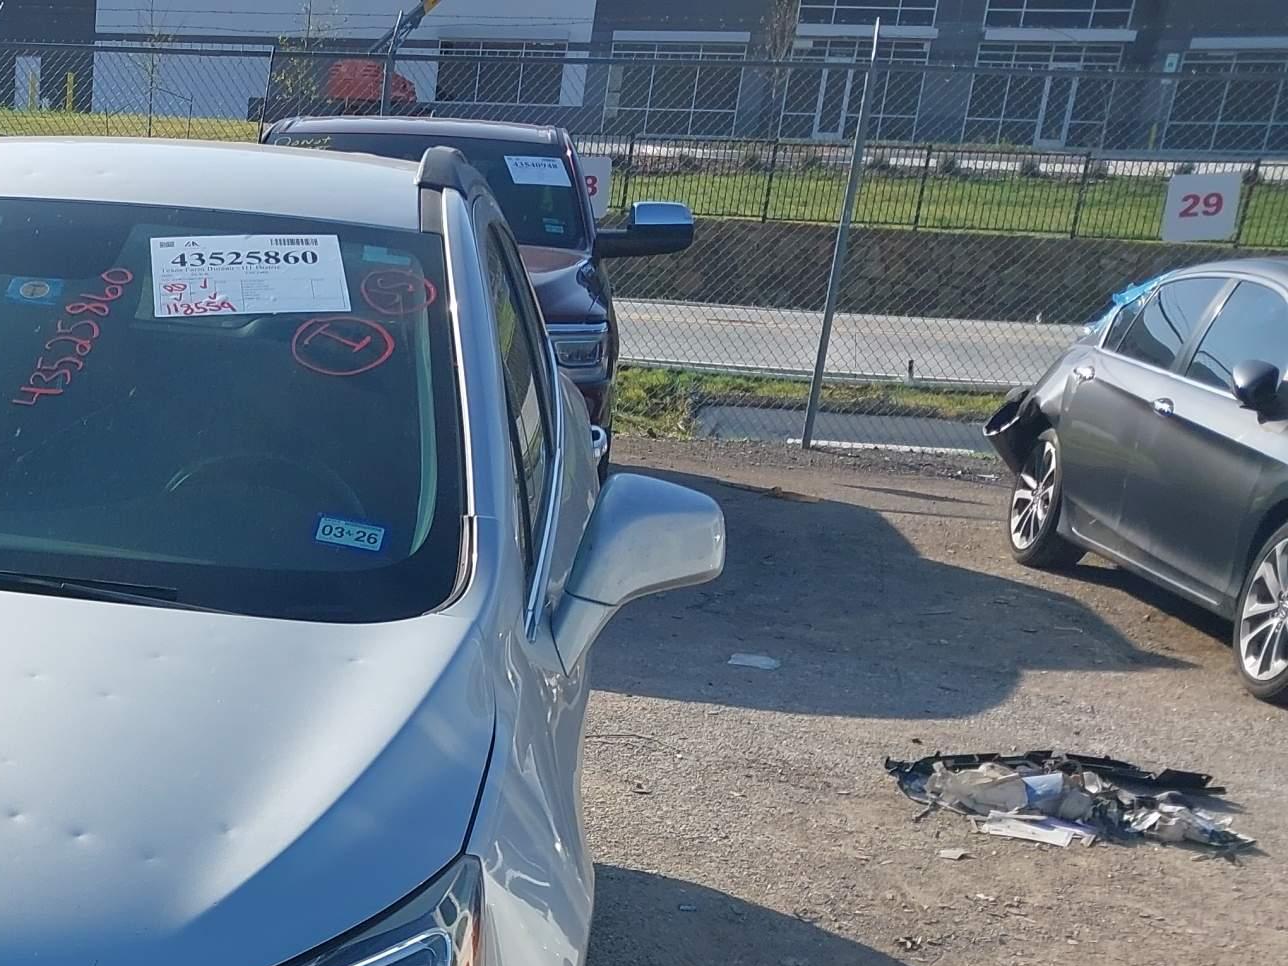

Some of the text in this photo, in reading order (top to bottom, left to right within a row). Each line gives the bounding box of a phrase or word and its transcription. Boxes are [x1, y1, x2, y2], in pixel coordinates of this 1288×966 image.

[1179, 191, 1224, 217] 29
[171, 250, 318, 267] 43525860
[166, 301, 237, 315] 118559
[12, 267, 133, 405] 43525860
[321, 524, 345, 538] 03
[354, 530, 379, 545] 26
